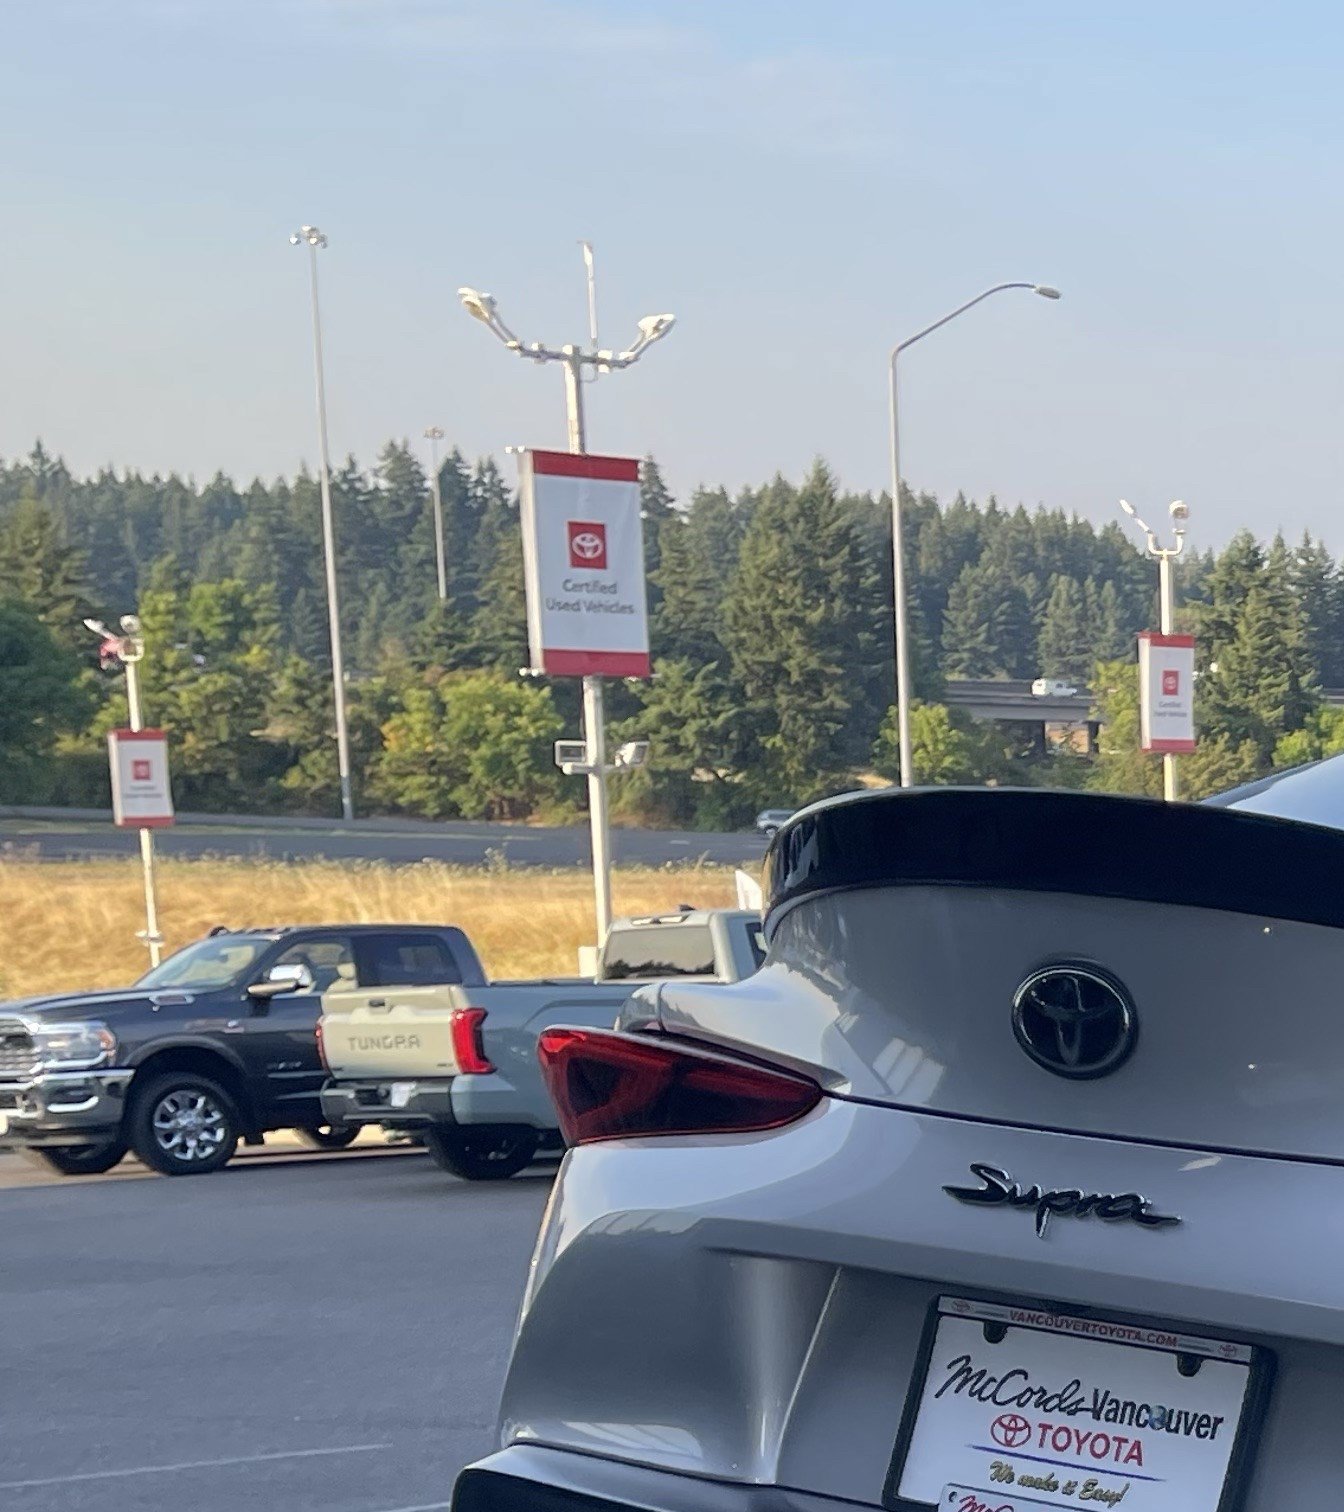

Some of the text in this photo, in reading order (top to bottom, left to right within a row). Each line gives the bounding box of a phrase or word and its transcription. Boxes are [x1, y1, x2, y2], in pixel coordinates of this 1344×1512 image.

[562, 579, 618, 595] Certified
[545, 598, 635, 615] Used Vehicles
[347, 1034, 421, 1051] TUNDRA
[941, 1161, 1183, 1239] Supra
[1009, 1309, 1178, 1347] VANCOUVERTOYOTA.COM
[1036, 1422, 1144, 1468] TOYOTA
